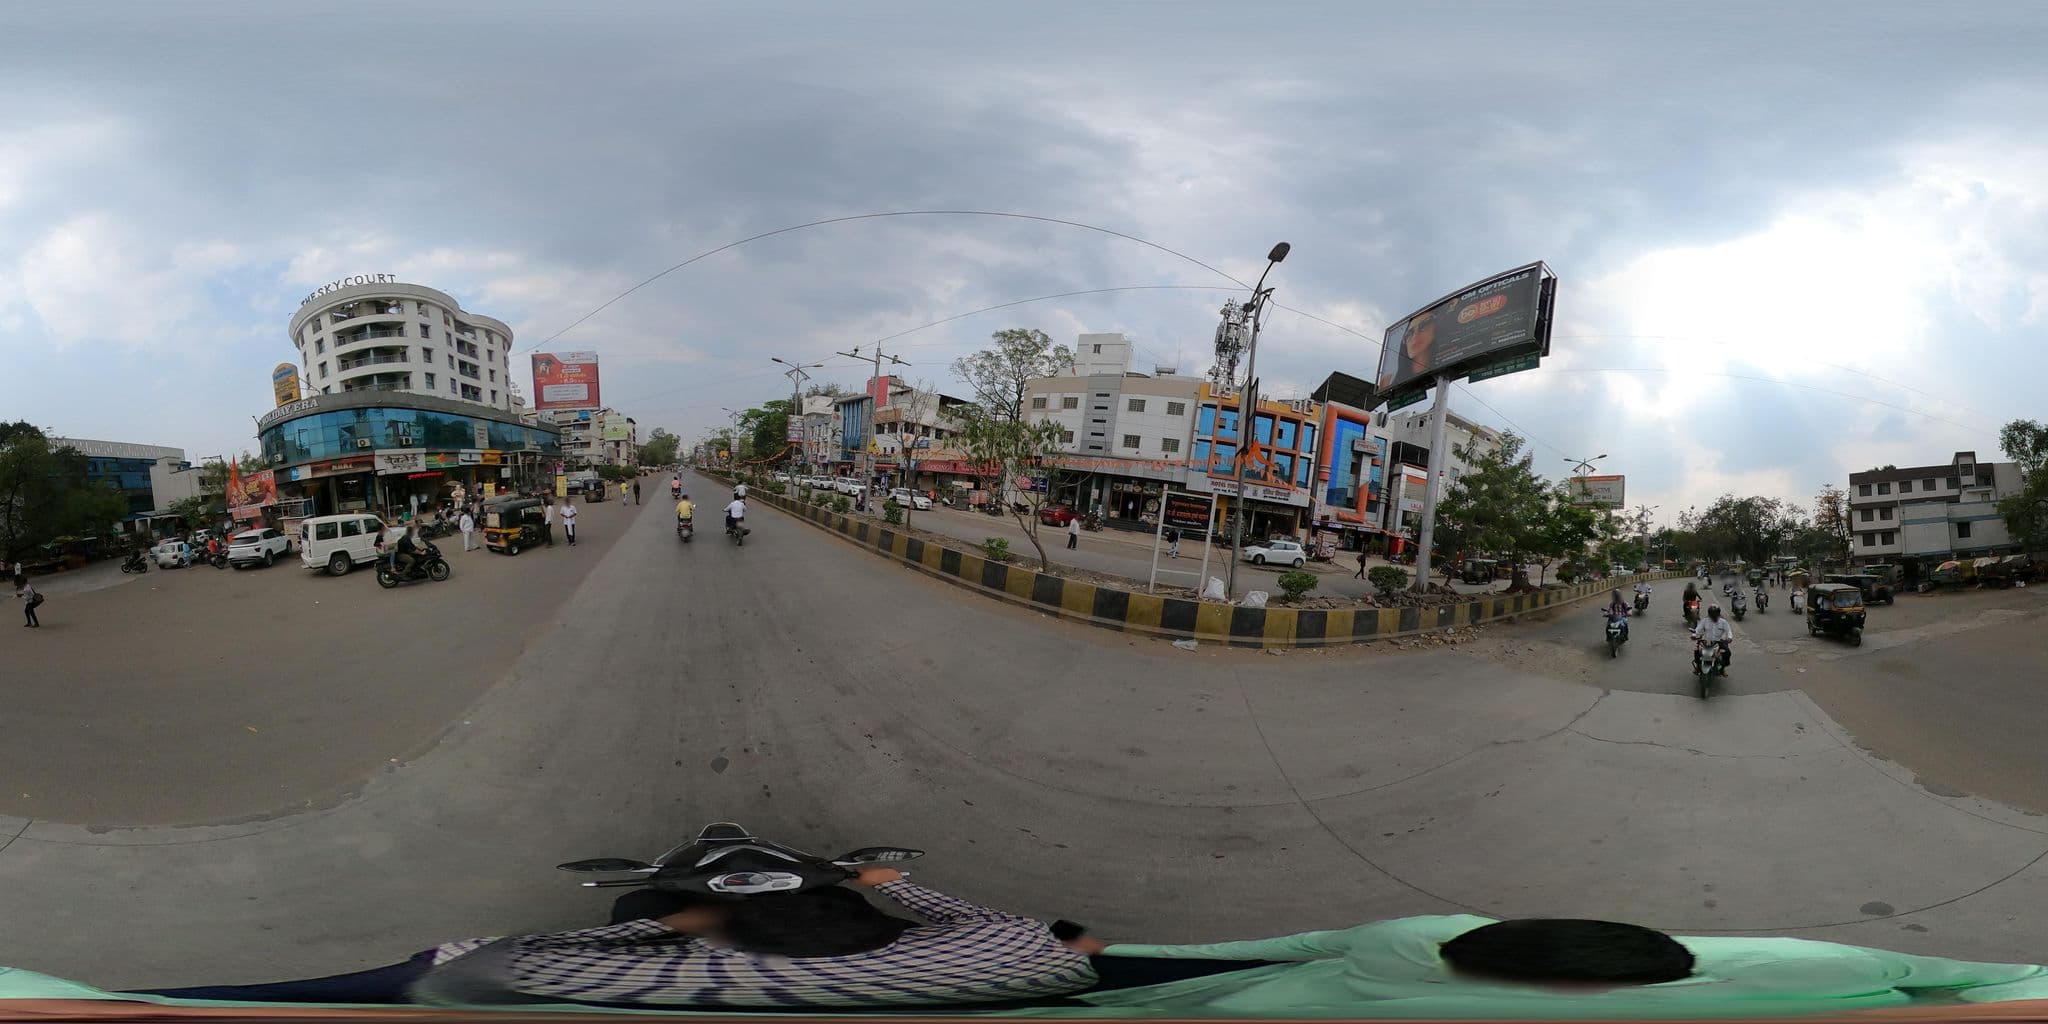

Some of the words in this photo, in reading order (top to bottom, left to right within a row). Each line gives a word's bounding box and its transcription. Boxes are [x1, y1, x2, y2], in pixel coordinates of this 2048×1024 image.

[317, 280, 341, 297] SKY
[344, 273, 396, 287] COURT
[1478, 273, 1530, 294] OPTICALS
[294, 399, 320, 412] ERA
